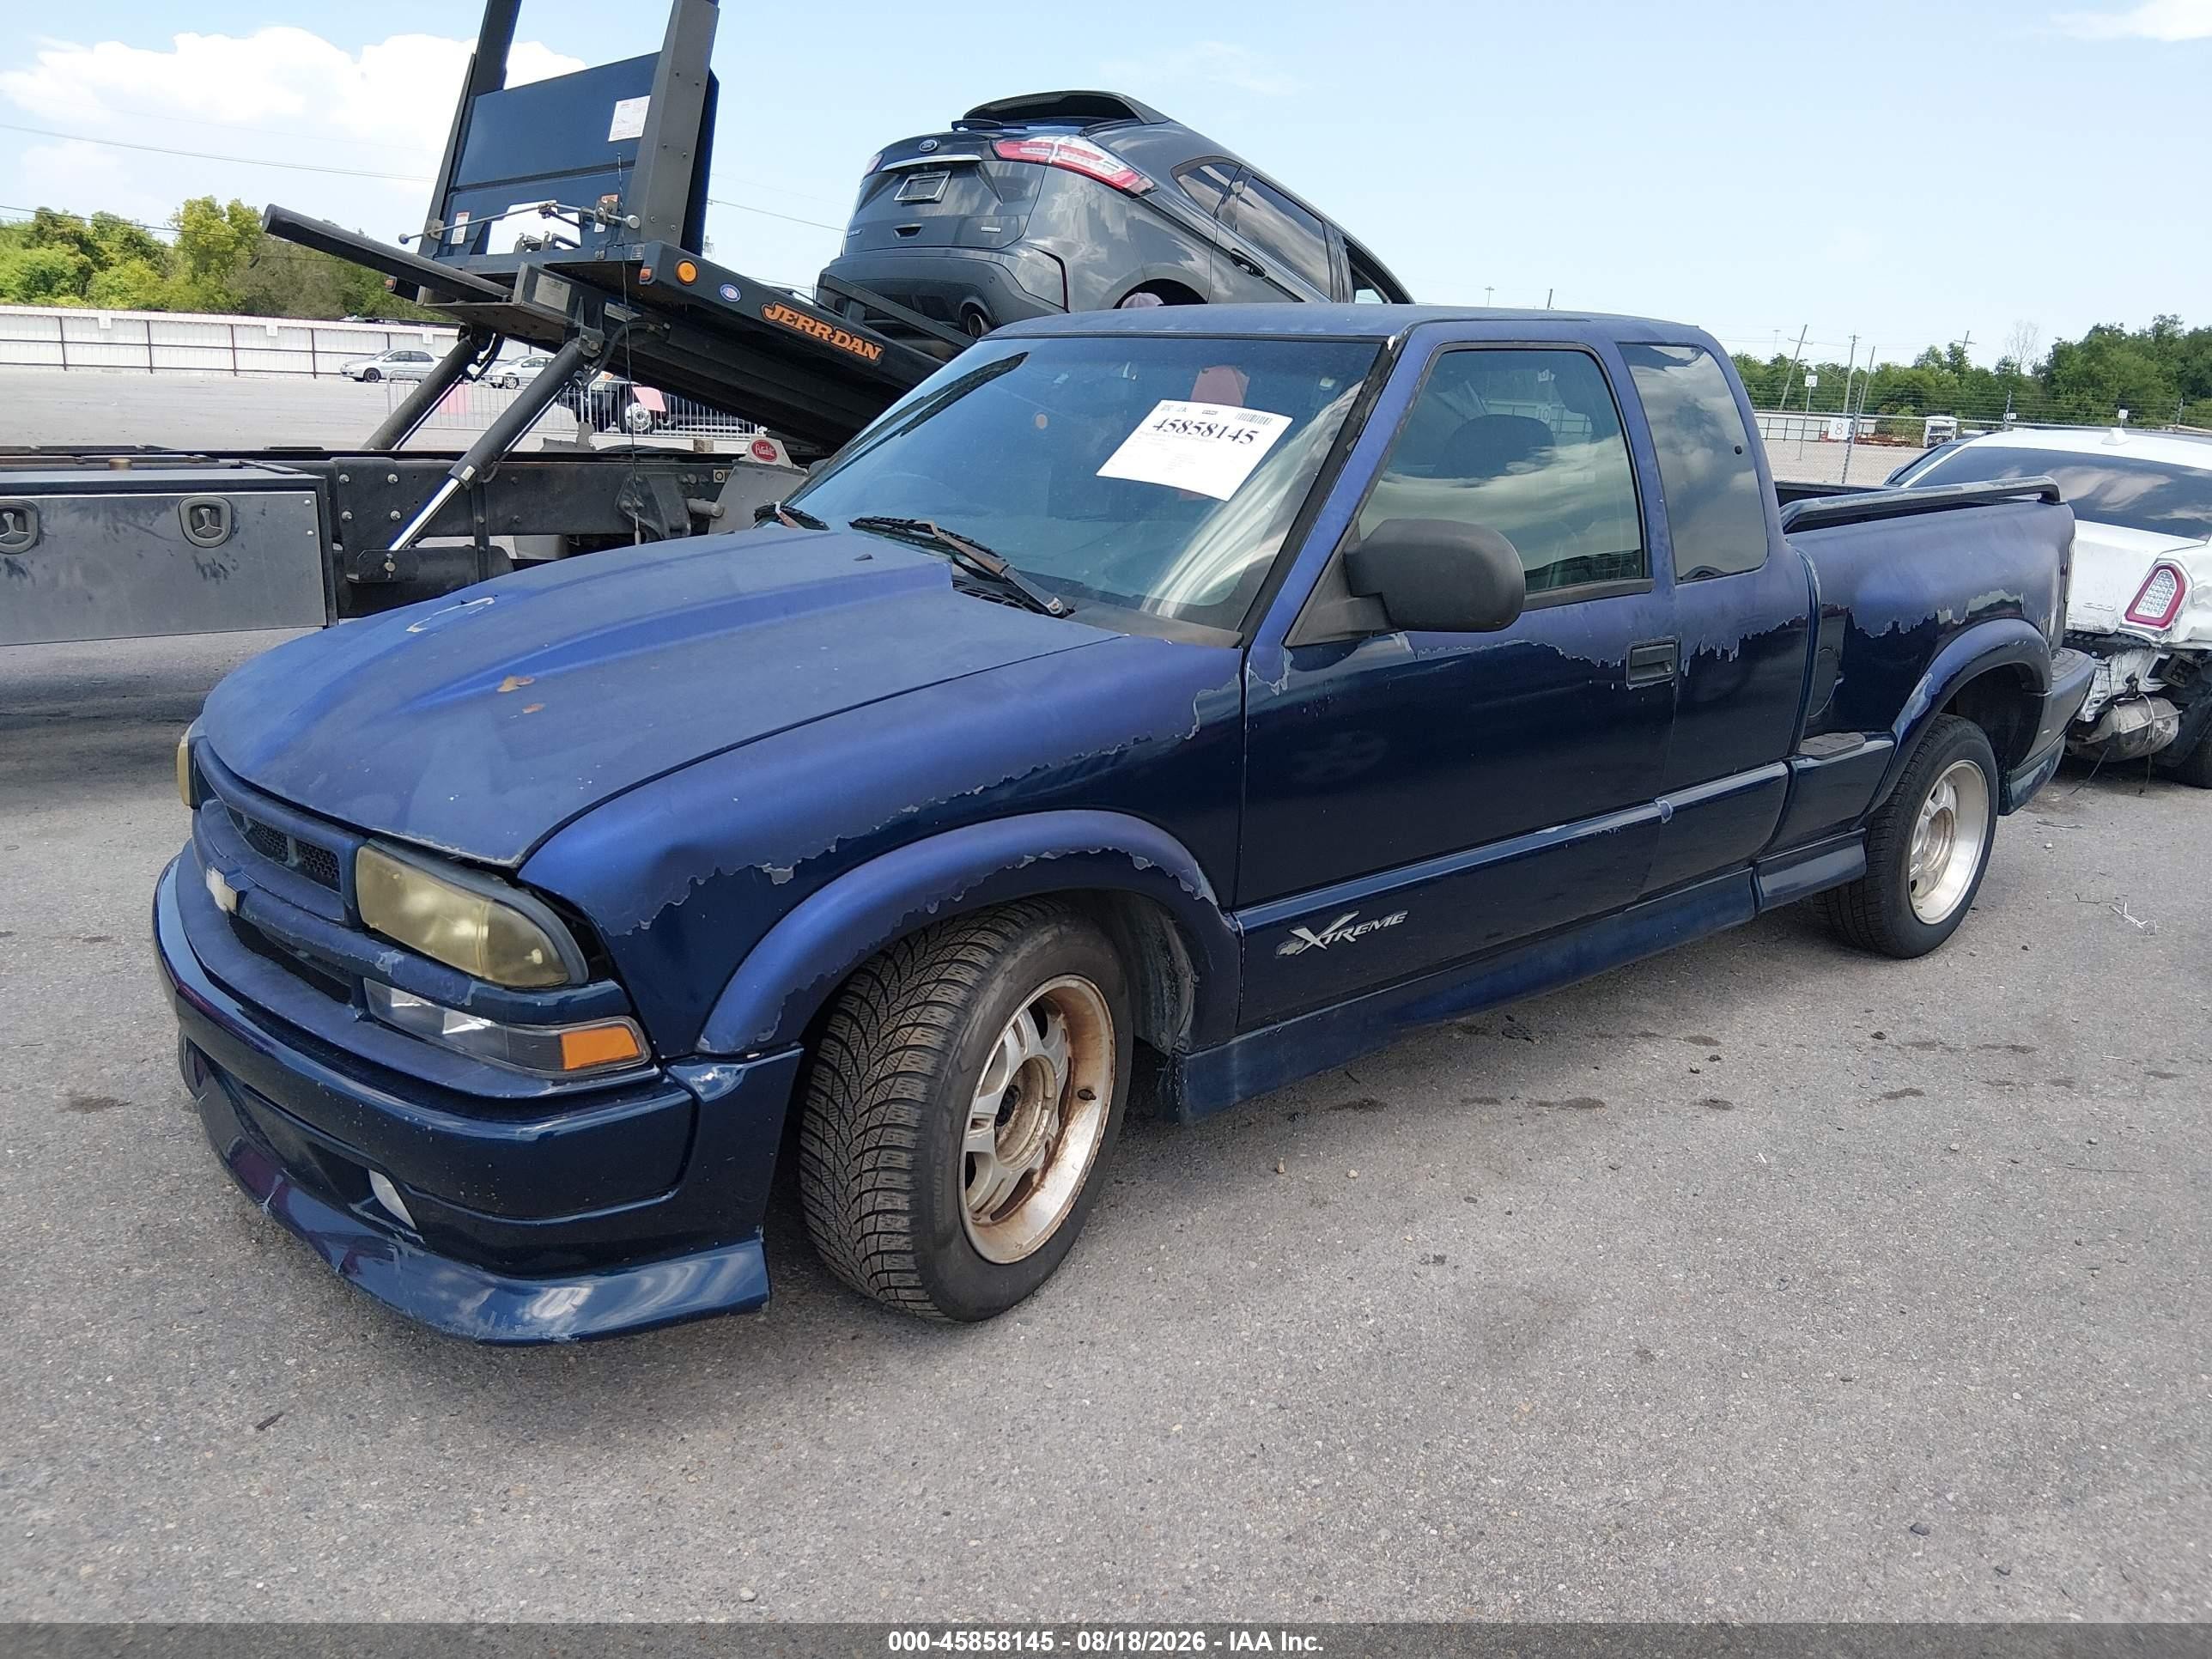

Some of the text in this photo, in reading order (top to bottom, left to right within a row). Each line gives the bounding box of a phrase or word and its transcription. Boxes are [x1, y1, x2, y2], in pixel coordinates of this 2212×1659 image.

[1152, 417, 1260, 445] 45858145
[1834, 422, 1844, 435] 8
[1289, 910, 1409, 956] XTREME
